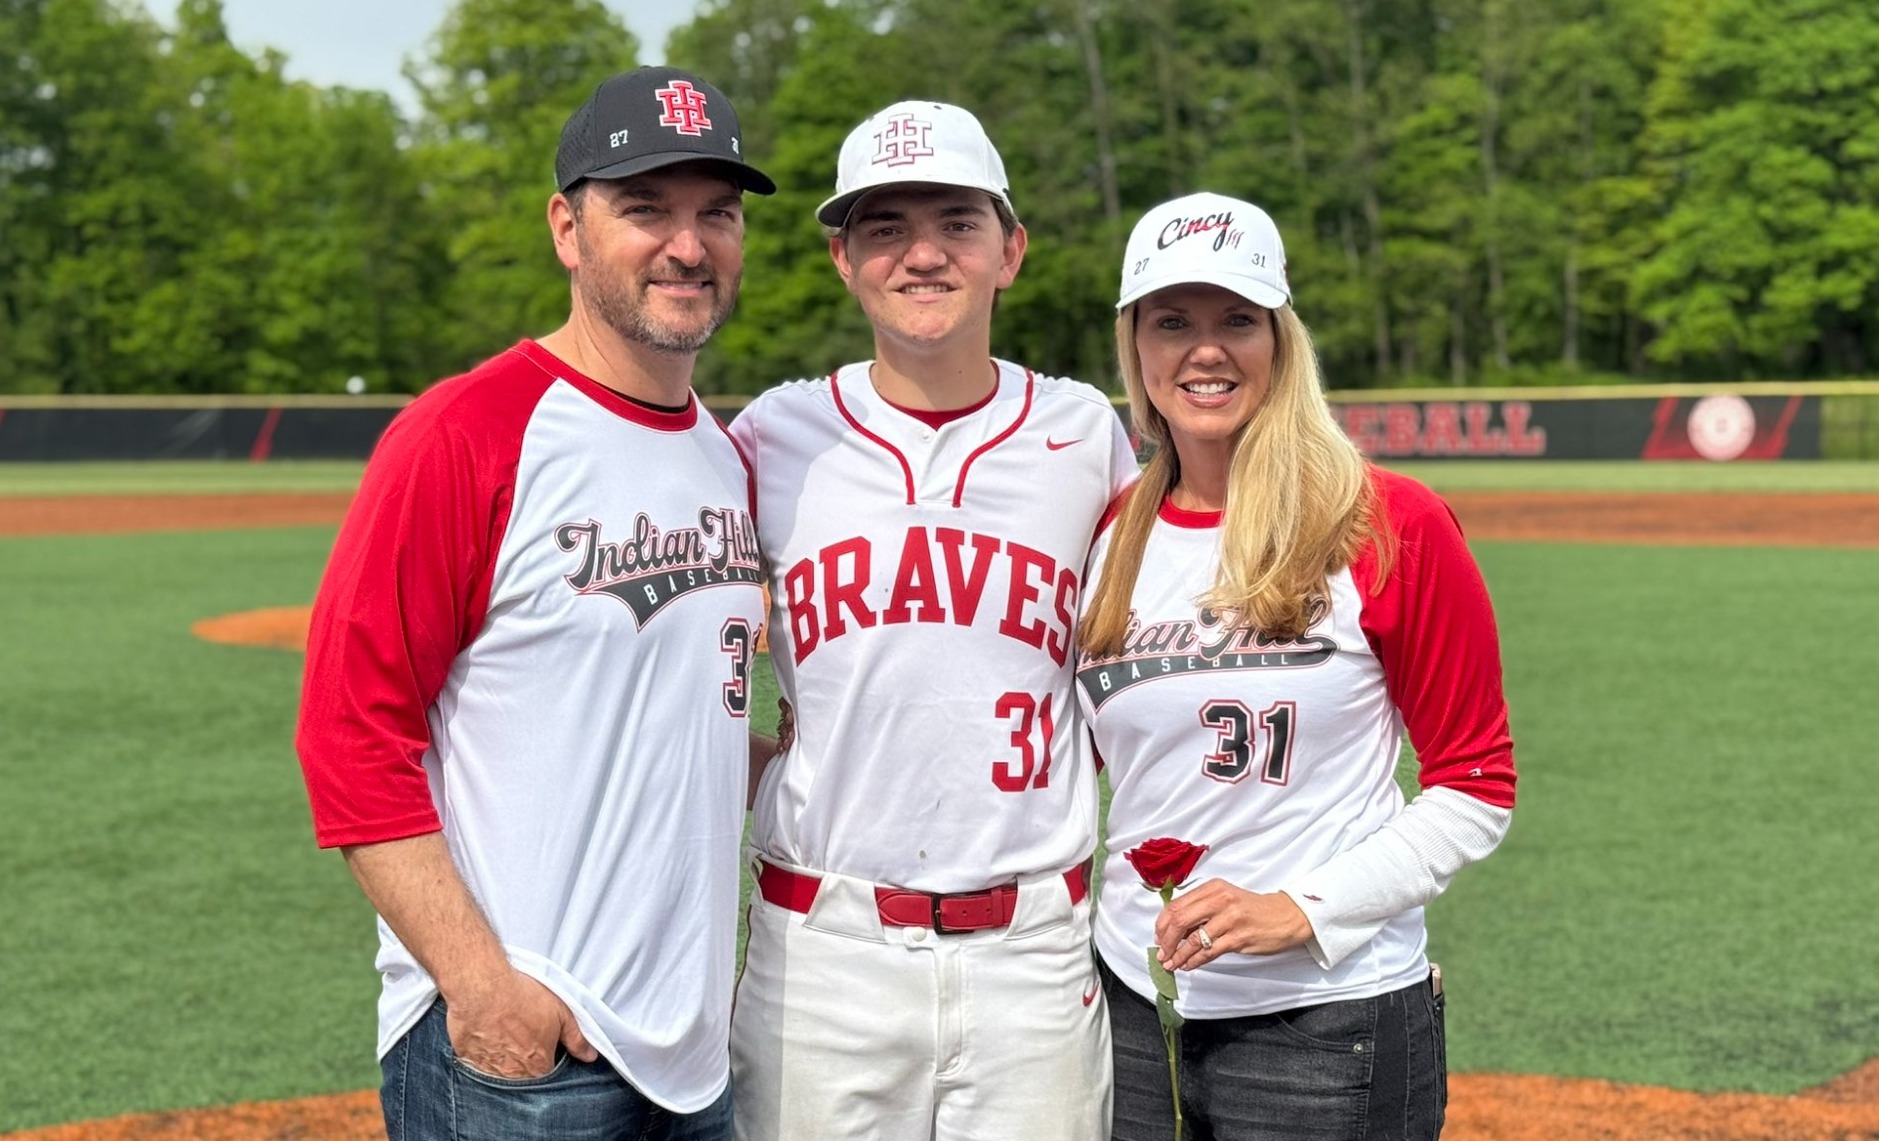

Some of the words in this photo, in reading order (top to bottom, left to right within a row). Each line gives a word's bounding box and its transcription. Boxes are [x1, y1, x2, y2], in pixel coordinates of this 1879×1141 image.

[609, 129, 629, 149] 27
[1157, 211, 1234, 252] Cincy
[1133, 257, 1150, 275] 27
[1251, 253, 1267, 268] 31
[1332, 401, 1547, 456] EBALL
[554, 512, 706, 593] Indian
[785, 526, 1078, 668] BRAVES
[1079, 609, 1199, 666] ian
[720, 617, 762, 718] 3
[1099, 654, 1288, 692] BASEBALL
[992, 691, 1054, 792] 31
[1198, 699, 1297, 787] 31
